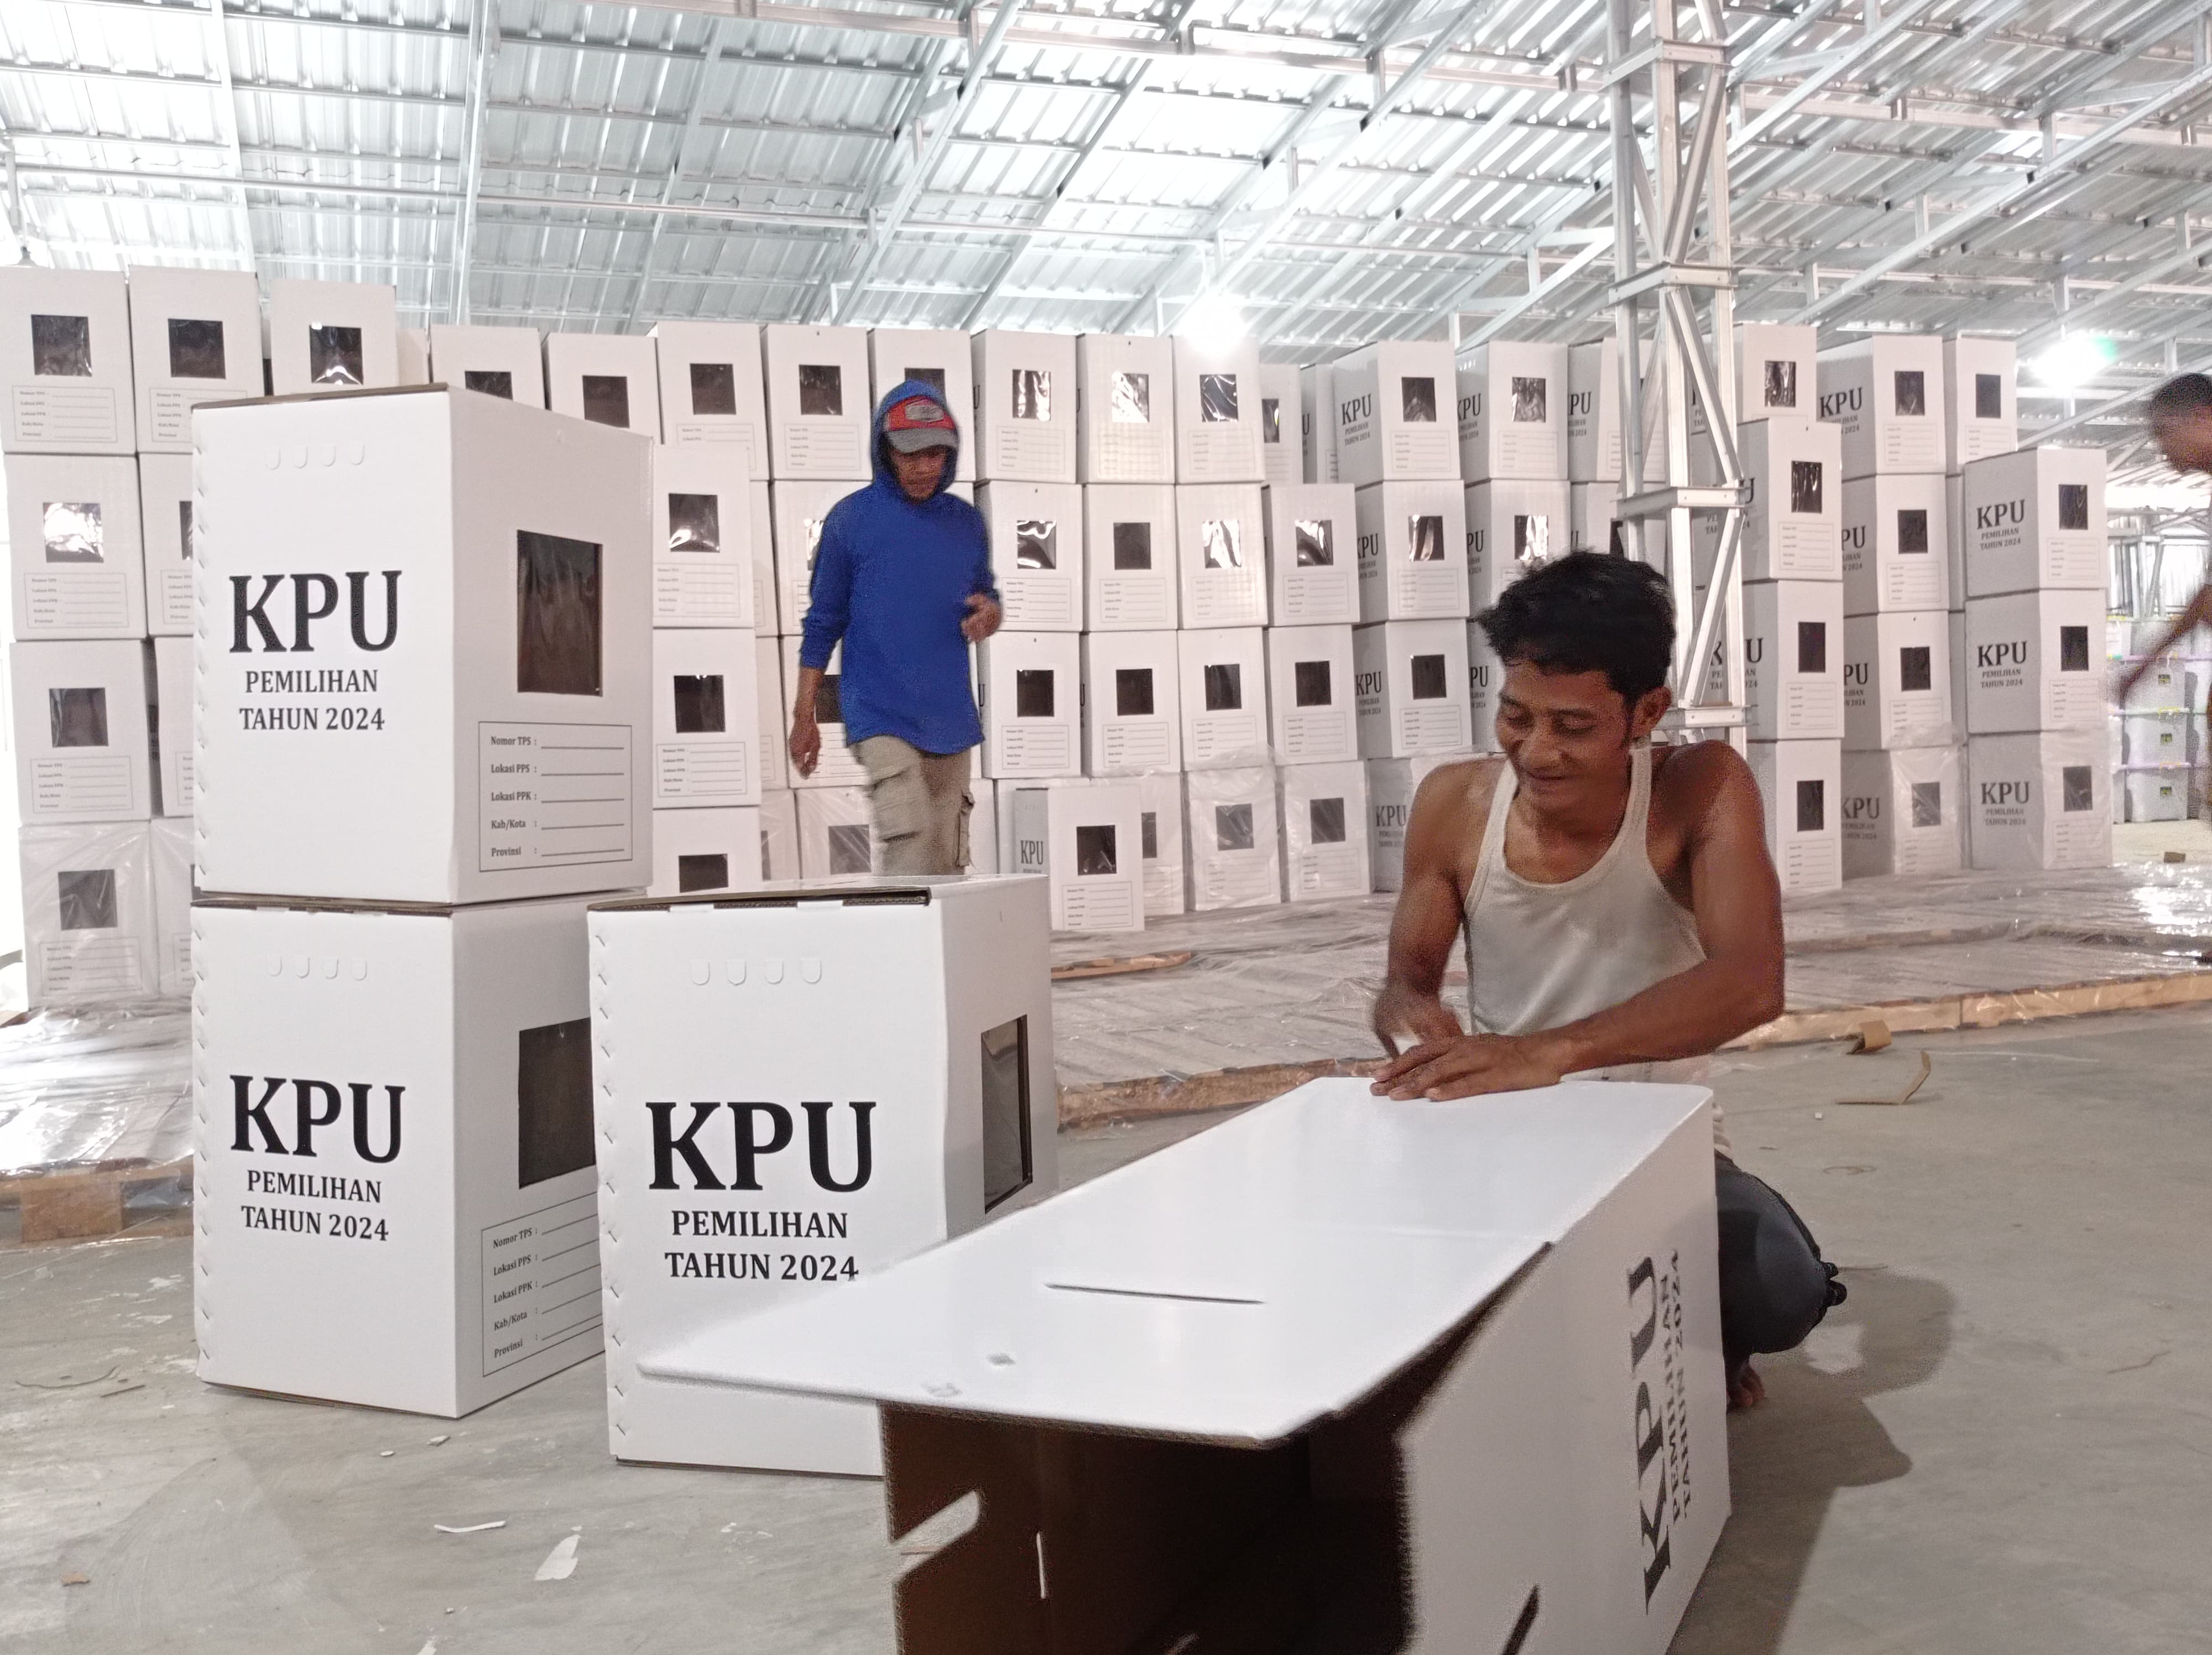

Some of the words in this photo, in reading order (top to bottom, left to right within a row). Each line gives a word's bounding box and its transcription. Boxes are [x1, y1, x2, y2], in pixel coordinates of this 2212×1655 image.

[1341, 393, 1371, 426] KPU
[1568, 392, 1592, 415] PU
[1820, 387, 1862, 418] KPU
[1977, 499, 2025, 529] KPU
[1468, 530, 1484, 555] PU
[1842, 525, 1866, 551] PU
[1980, 540, 2002, 550] TAHUN
[2005, 537, 2021, 547] 2024
[1981, 527, 2019, 540] PEMILIHAN
[229, 570, 402, 653] KPU
[1978, 641, 2027, 668] KPU
[246, 669, 378, 693] PEMILIHAN
[1355, 671, 1381, 696] KPU
[1470, 666, 1489, 688] PU
[1844, 663, 1869, 686] PU
[1980, 679, 2004, 688] TAHUN
[2006, 678, 2022, 686] 2024
[1982, 668, 2021, 678] PEMILIHAN
[239, 707, 319, 730] TAHUN
[326, 707, 385, 730] 2024
[491, 736, 515, 746] Nomor
[517, 736, 531, 746] TPS
[491, 763, 515, 773] Lokasi
[517, 763, 530, 773] PPS
[491, 792, 515, 802] Lokasi
[517, 792, 531, 800] PPK
[1981, 781, 2030, 805] KPU
[491, 819, 526, 830] Kab/Kota
[1375, 805, 1406, 827] KPU
[491, 846, 521, 857] Provinsi
[1021, 840, 1044, 865] KPU
[229, 1075, 406, 1163] KPU
[645, 1101, 877, 1193] KPU
[247, 1169, 382, 1203] PEMILIHAN
[241, 1205, 321, 1235] TAHUN
[329, 1214, 389, 1242] 2024
[671, 1210, 848, 1238] PEMILIHAN
[493, 1235, 518, 1248] Nomor
[519, 1227, 532, 1240] TPS
[494, 1260, 517, 1276] Lokasi
[518, 1255, 531, 1267] PPS
[665, 1252, 770, 1279] TAHUN
[780, 1255, 859, 1281] 2024
[494, 1286, 517, 1303] Lokasi
[518, 1281, 533, 1294] PPK
[494, 1311, 527, 1331] Kab/Kota
[494, 1338, 523, 1358] Provinsi
[1660, 1274, 1679, 1526] PEMILIHAN
[1629, 1256, 1671, 1616] KPU
[1678, 1367, 1690, 1519] TAHUN
